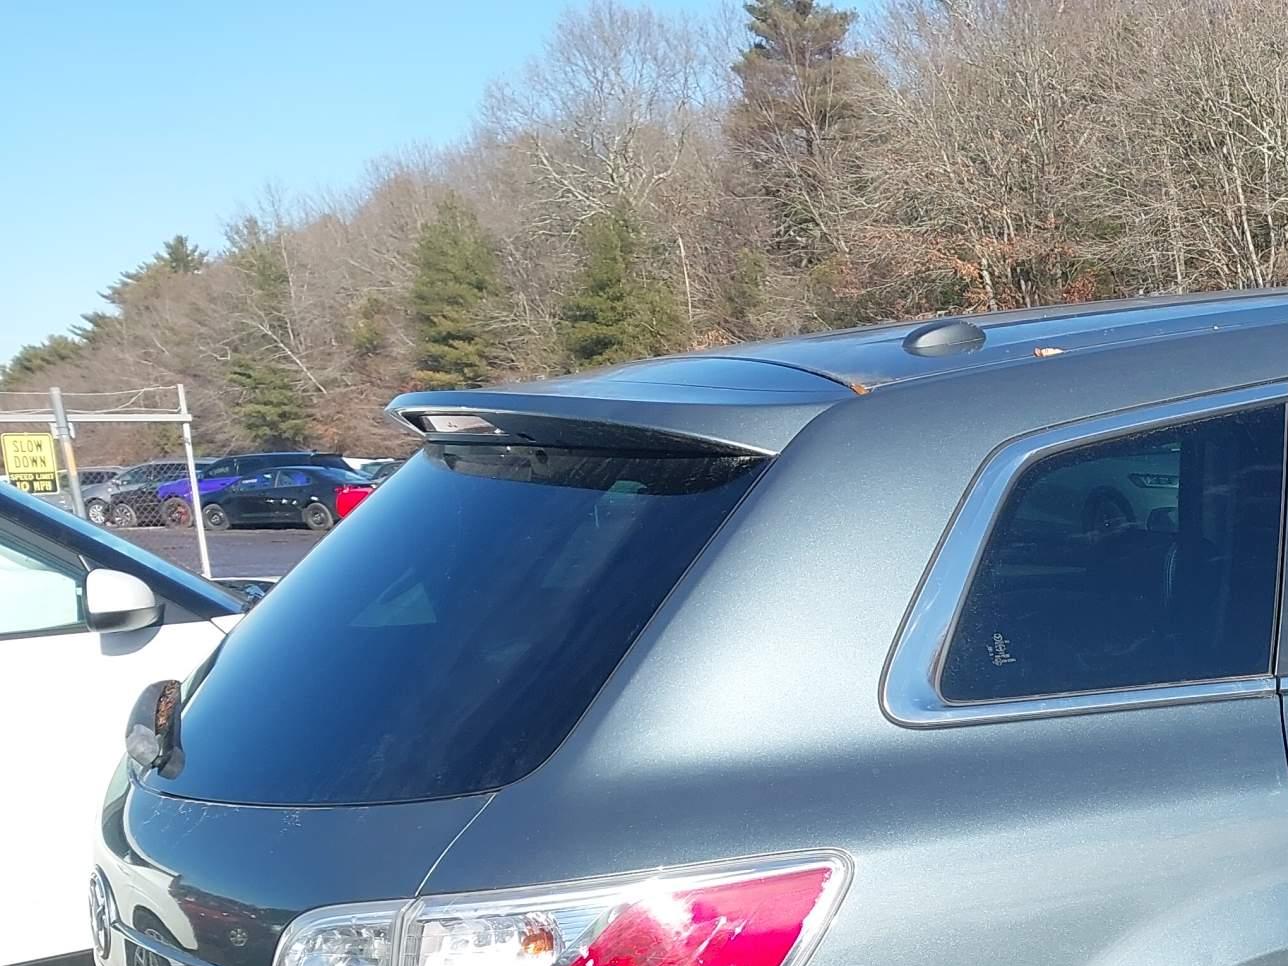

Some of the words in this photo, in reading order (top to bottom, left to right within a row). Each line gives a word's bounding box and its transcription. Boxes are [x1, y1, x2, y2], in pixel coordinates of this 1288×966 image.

[12, 440, 42, 453] SLOW
[13, 455, 47, 469] DOWN
[9, 473, 34, 481] SPEED
[16, 480, 30, 491] 10
[32, 480, 52, 491] MPH
